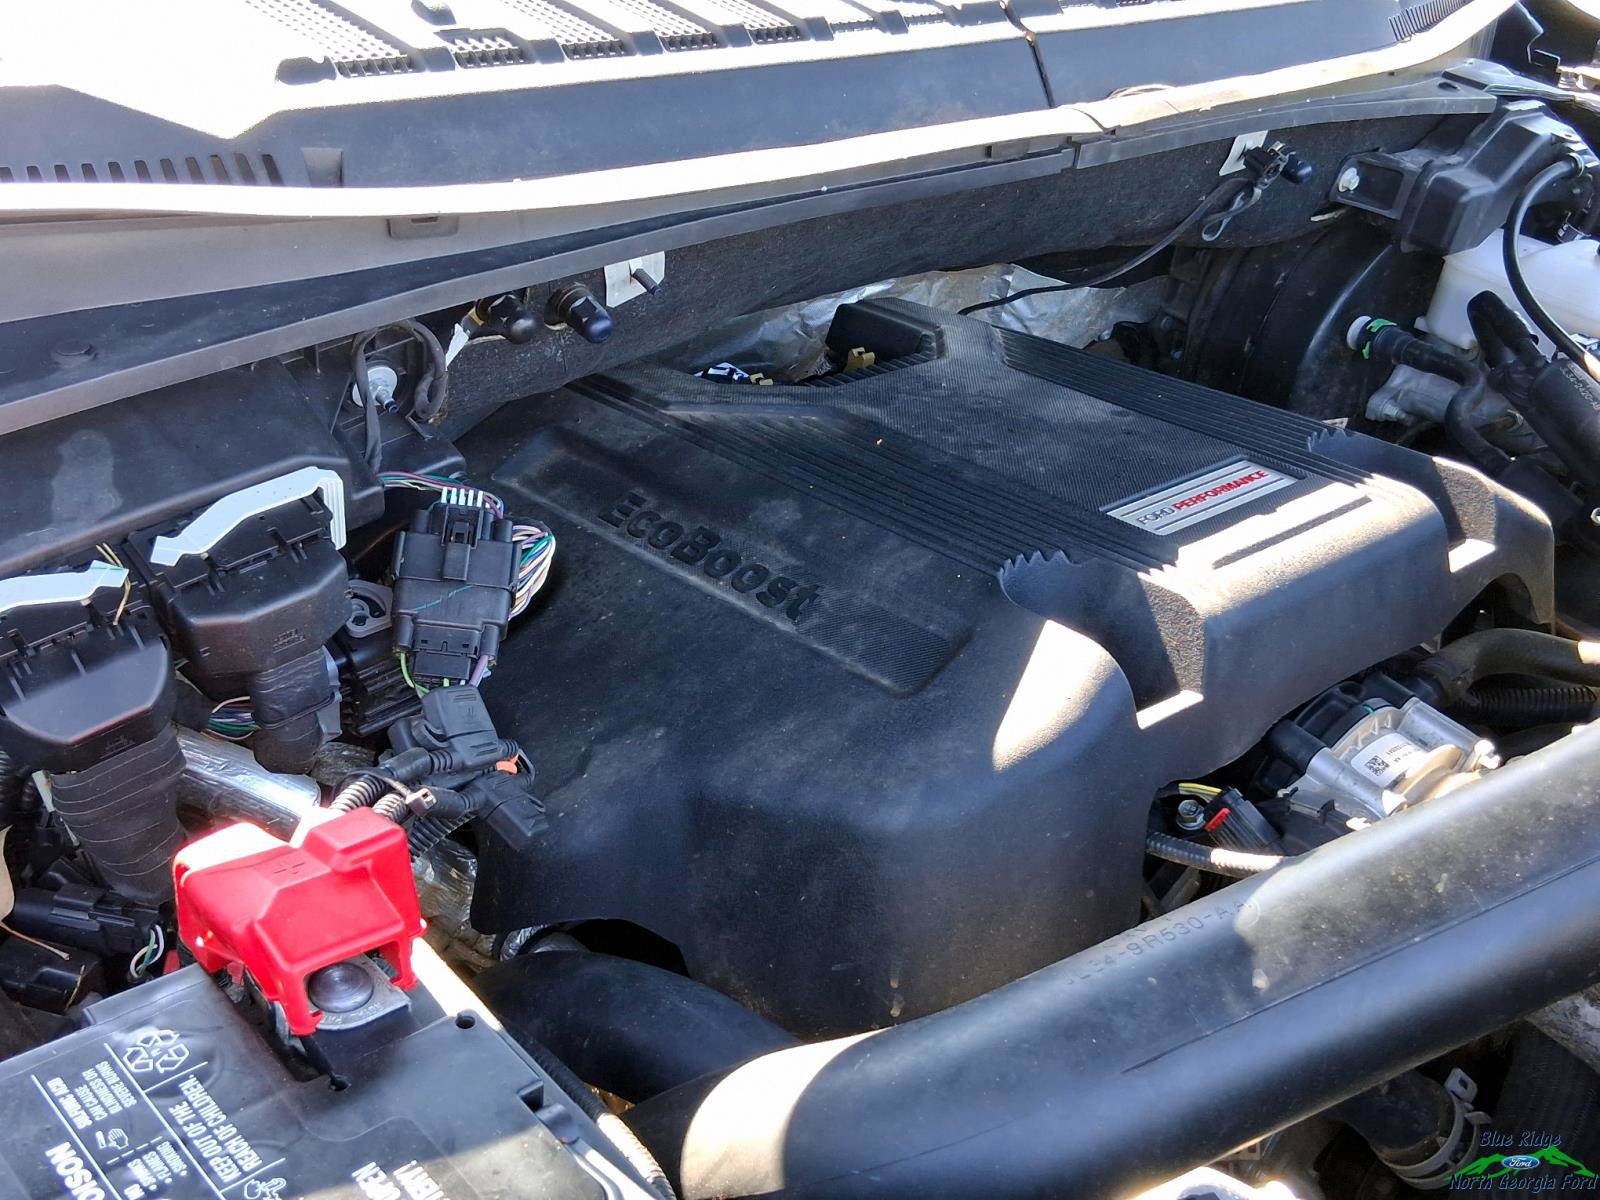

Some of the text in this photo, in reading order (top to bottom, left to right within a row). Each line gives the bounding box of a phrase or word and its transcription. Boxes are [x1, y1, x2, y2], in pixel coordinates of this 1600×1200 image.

[1136, 470, 1268, 526] FORD PERFORMANCE
[597, 489, 821, 622] EcoBoost
[168, 1101, 242, 1182] KEEP OUT OF THE
[178, 1074, 262, 1172] REACH OF CHILDREN.
